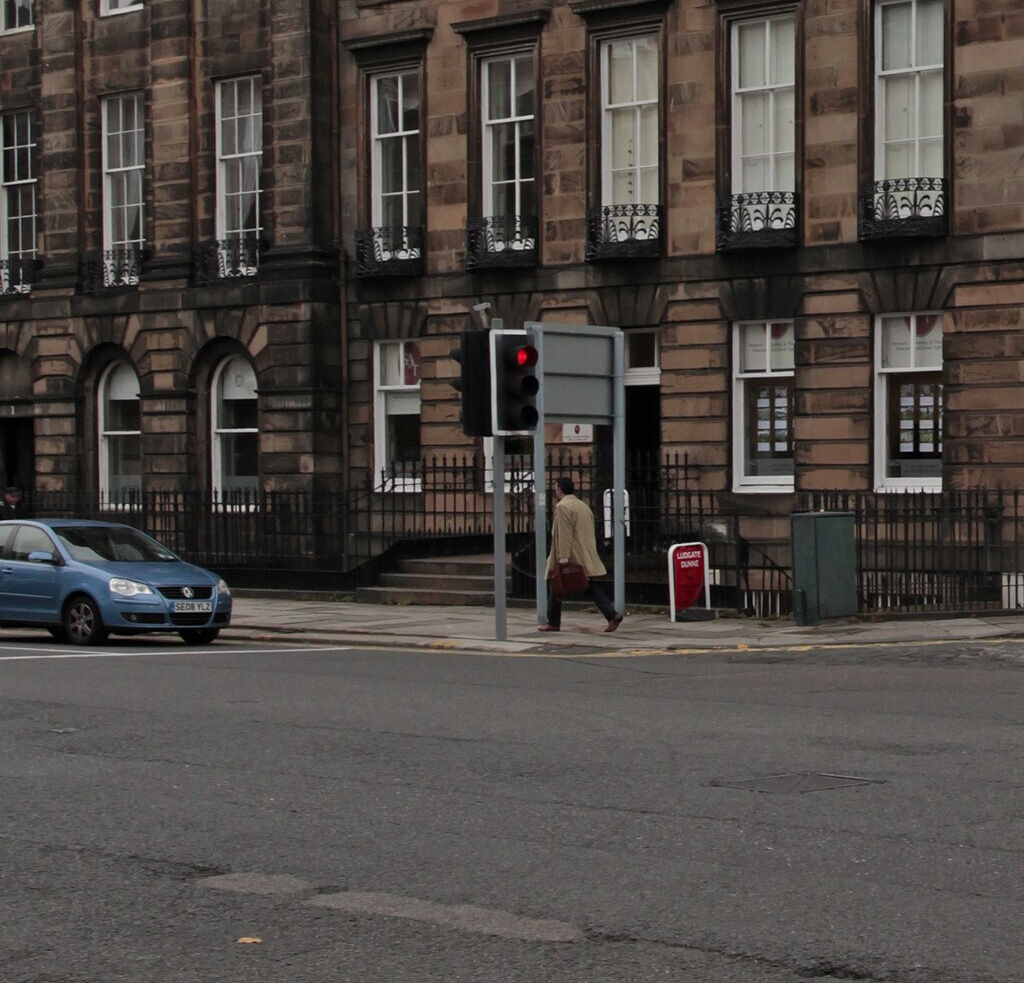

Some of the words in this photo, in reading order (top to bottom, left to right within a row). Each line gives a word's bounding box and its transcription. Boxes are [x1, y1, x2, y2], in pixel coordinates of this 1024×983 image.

[677, 550, 701, 559] LUDGATE
[681, 560, 699, 568] DUNNE
[175, 602, 195, 611] SE08
[196, 602, 211, 611] YLZ
